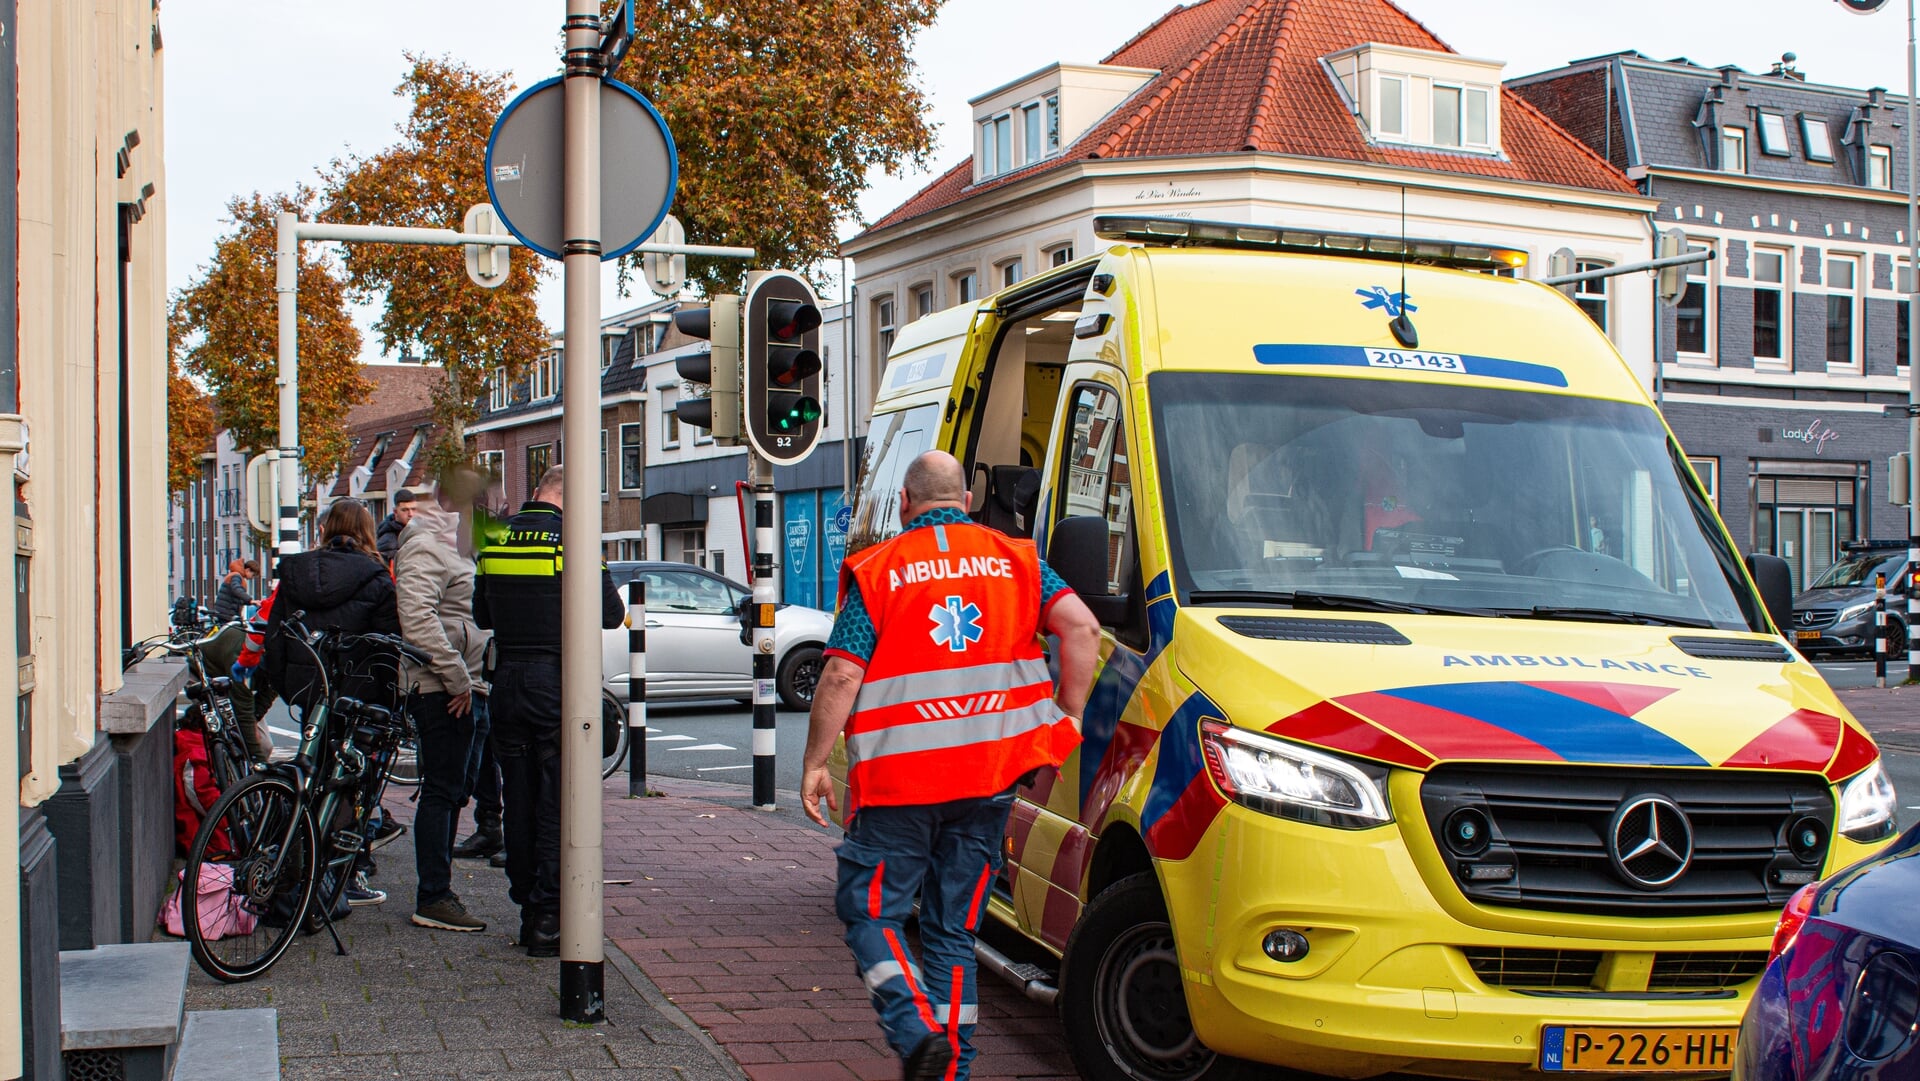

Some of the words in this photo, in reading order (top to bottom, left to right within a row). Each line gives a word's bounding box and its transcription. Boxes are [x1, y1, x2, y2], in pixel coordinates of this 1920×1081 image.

[1135, 190, 1145, 200] de
[1146, 190, 1165, 199] Vier
[1167, 187, 1201, 197] Winden
[1373, 351, 1457, 369] 20-143
[776, 437, 792, 447] 9.2
[788, 525, 808, 536] JANSEN
[789, 537, 807, 548] SPORT
[829, 535, 847, 546] SPORT
[888, 556, 1014, 592] AMBULANCE
[1442, 654, 1713, 680] AMBULANCE
[1546, 1052, 1560, 1064] NL
[1572, 1032, 1729, 1065] P-226-HH
